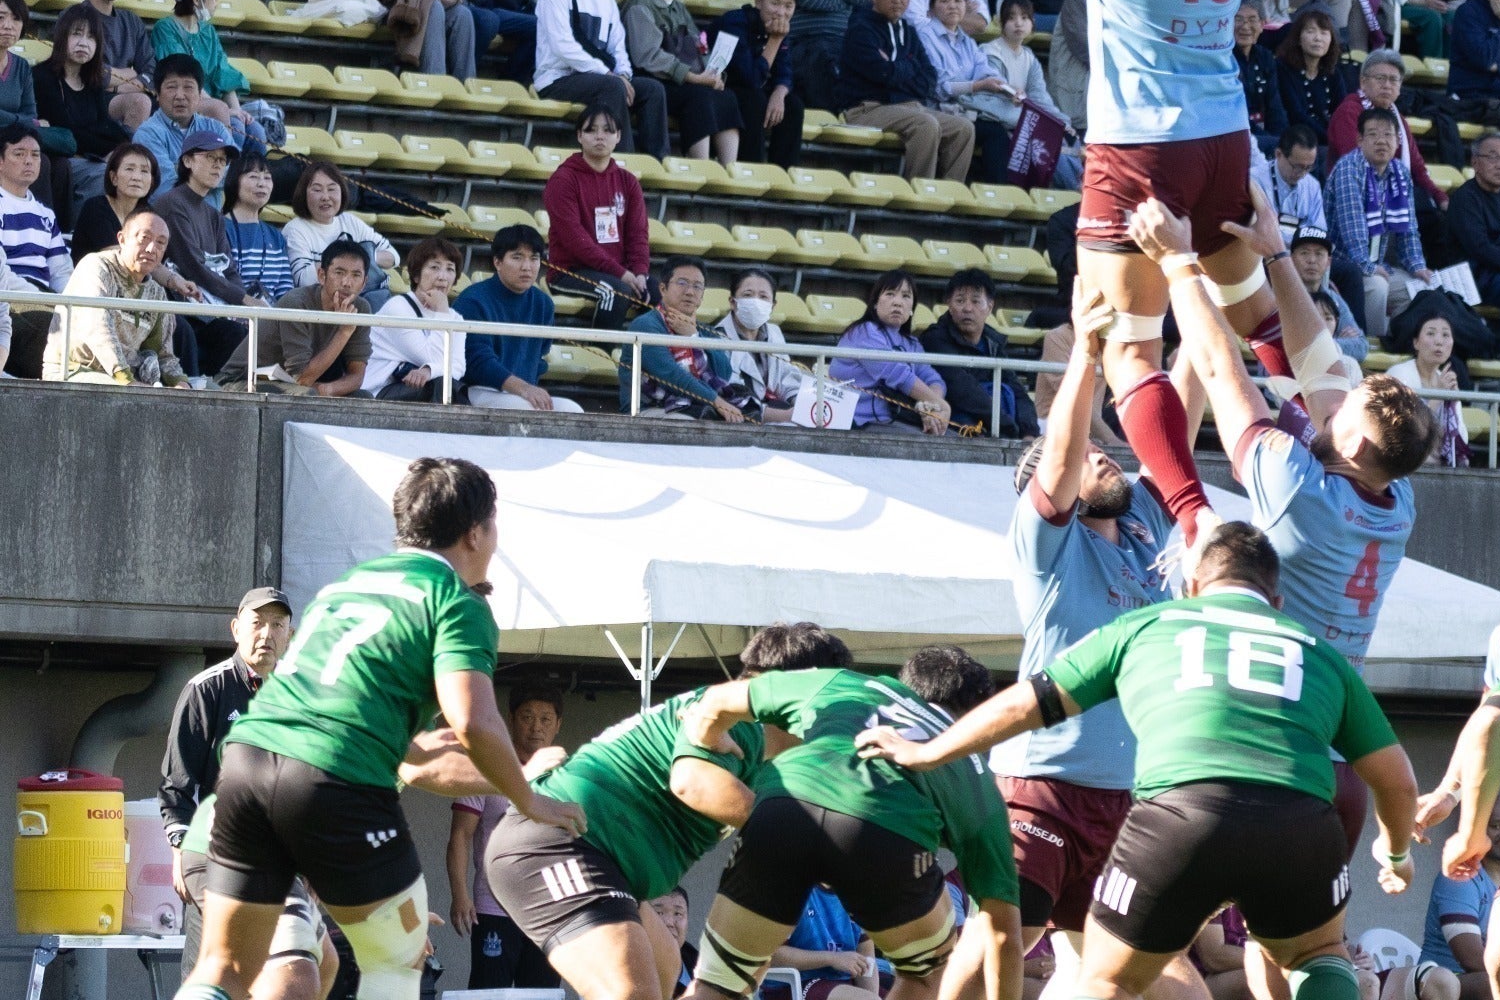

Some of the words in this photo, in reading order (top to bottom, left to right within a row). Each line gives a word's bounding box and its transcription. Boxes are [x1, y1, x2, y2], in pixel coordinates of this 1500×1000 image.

[1344, 539, 1382, 617] 4
[274, 601, 393, 686] 17
[1173, 625, 1304, 702] 18
[87, 808, 123, 820] IGLOO
